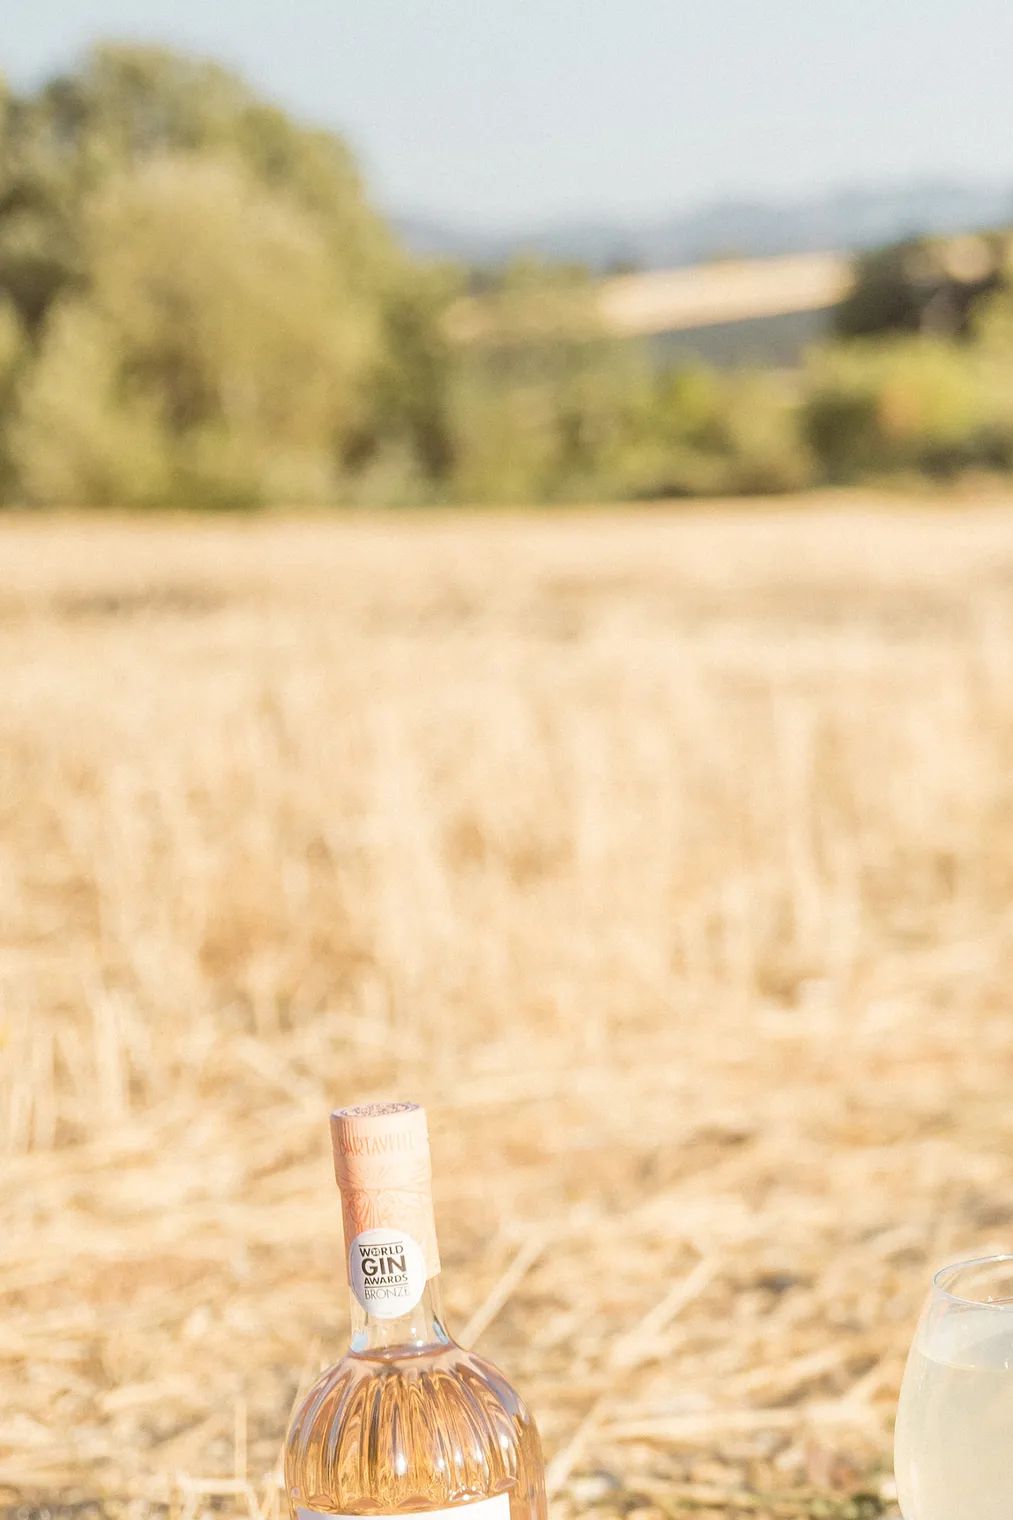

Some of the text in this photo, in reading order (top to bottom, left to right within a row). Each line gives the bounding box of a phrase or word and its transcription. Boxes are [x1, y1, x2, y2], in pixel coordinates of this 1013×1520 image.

[359, 1245, 404, 1257] WORLD
[361, 1255, 407, 1276] GIN
[364, 1273, 408, 1286] AWARDS
[364, 1286, 410, 1300] BRONZE
